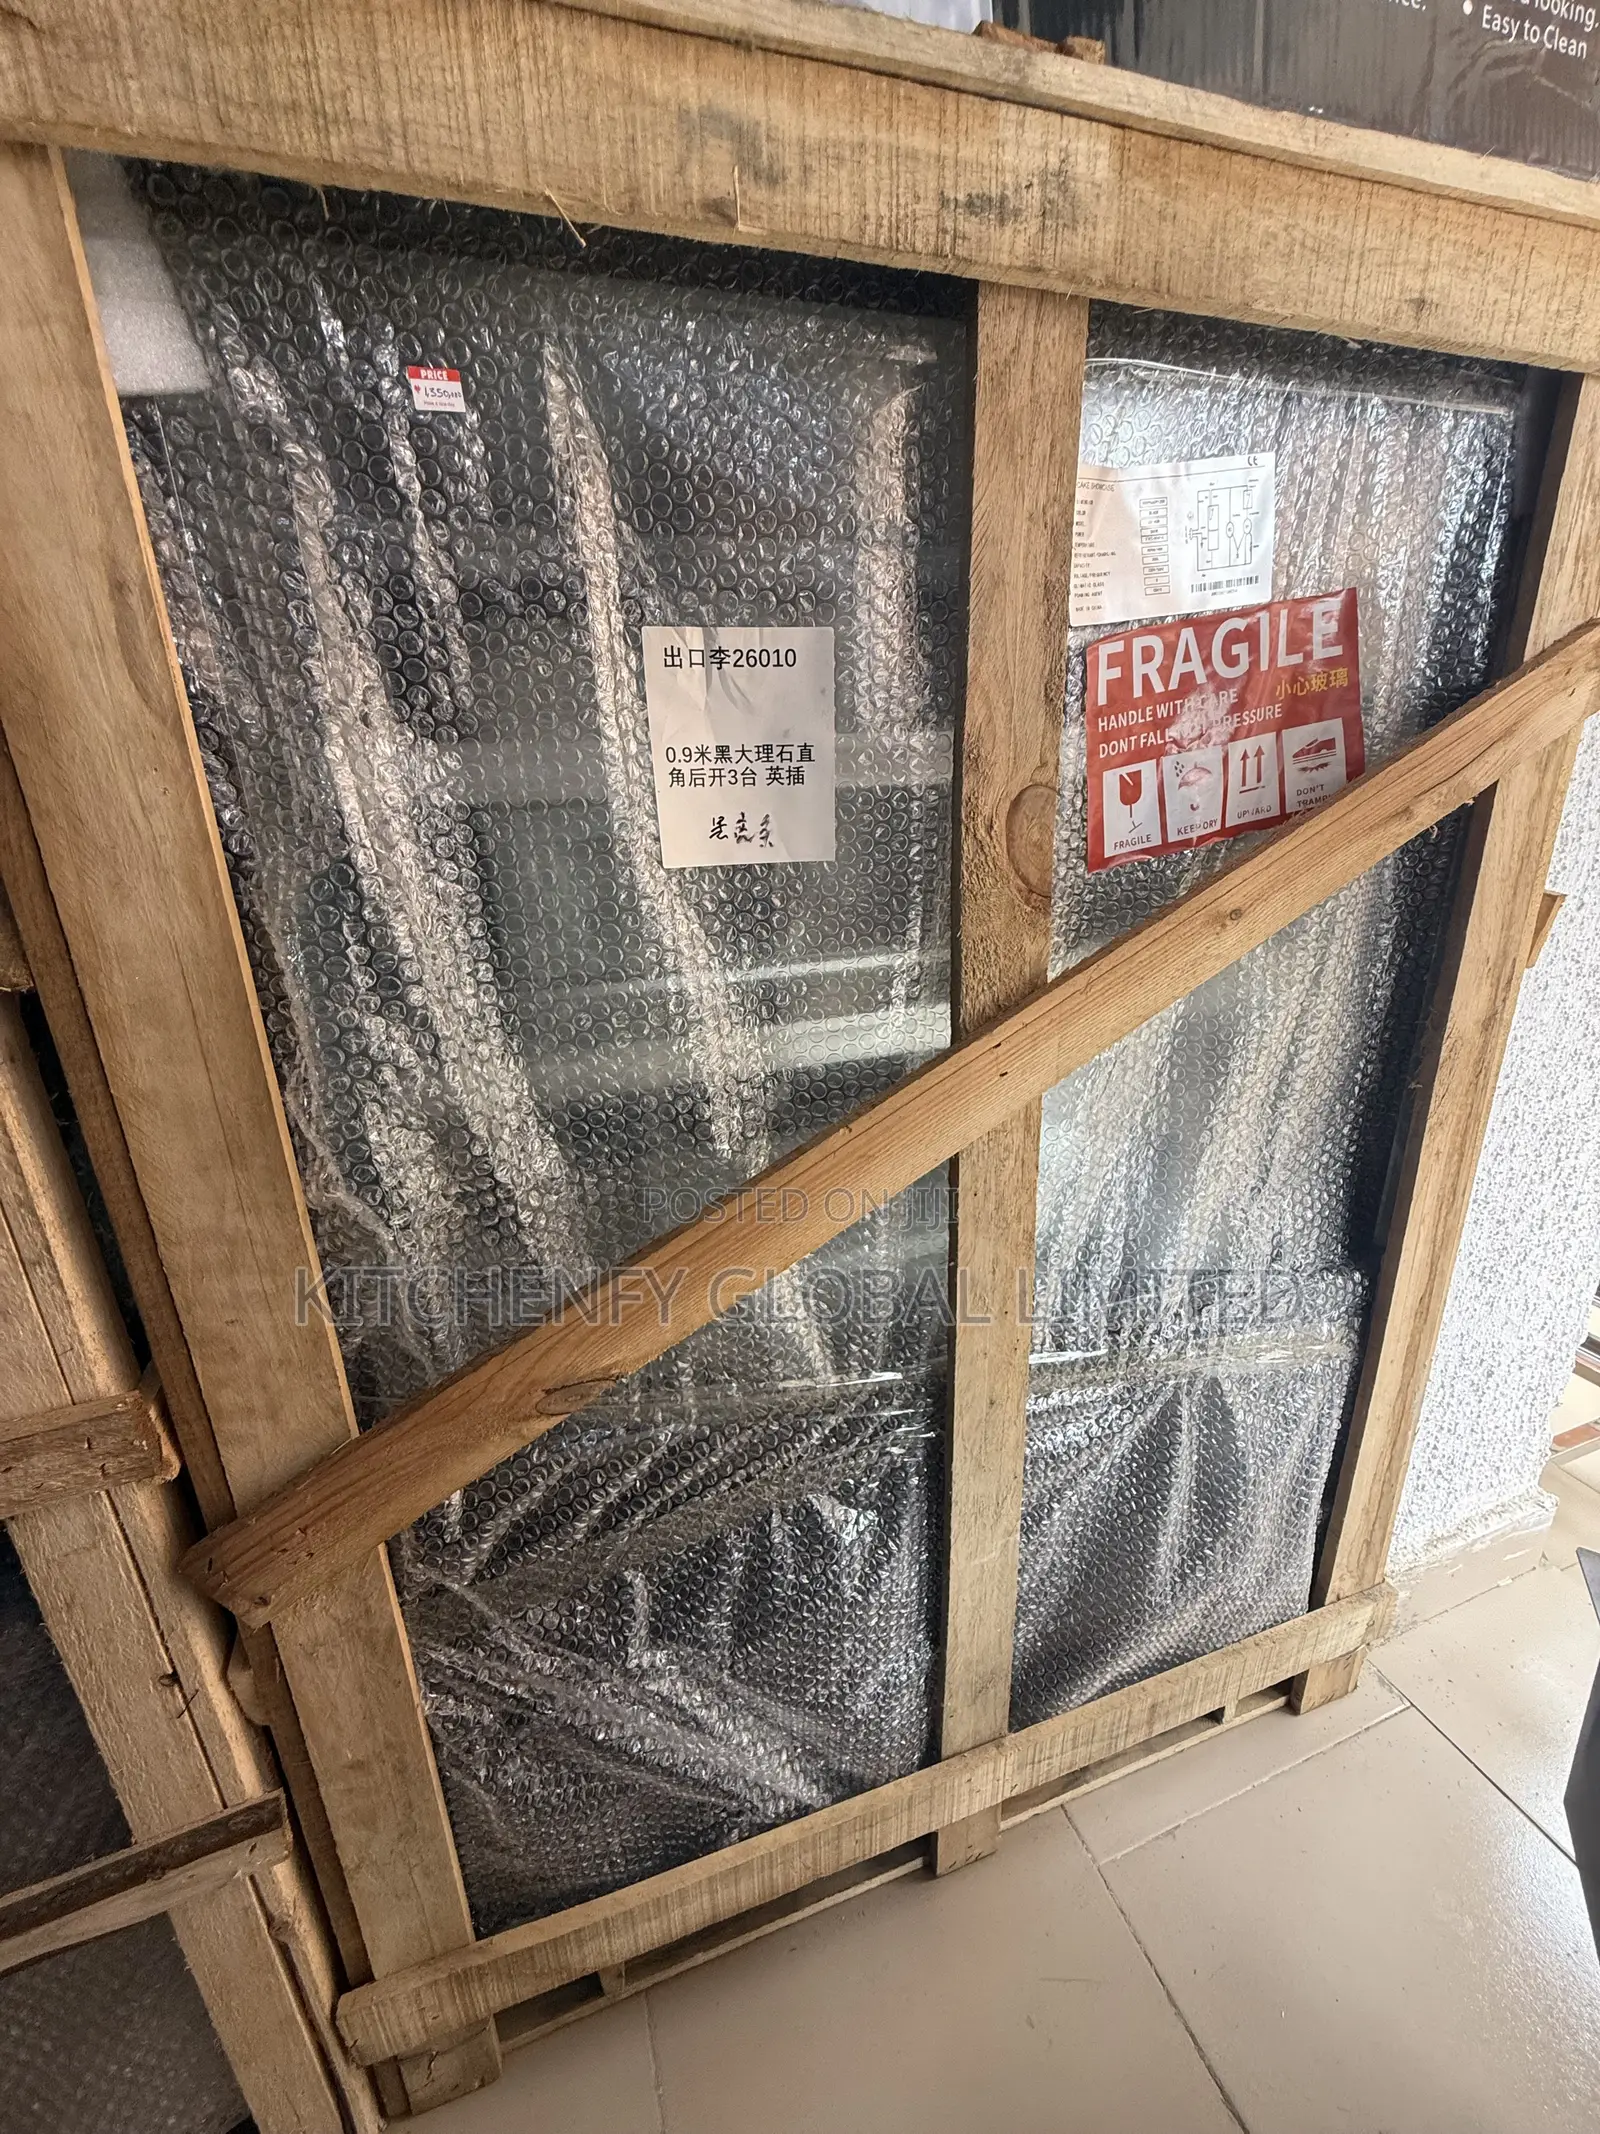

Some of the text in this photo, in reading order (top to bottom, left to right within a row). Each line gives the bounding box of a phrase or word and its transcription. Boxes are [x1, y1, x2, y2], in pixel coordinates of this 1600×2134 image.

[1482, 5, 1588, 59] Easy to Clean
[420, 369, 448, 380] PRICE
[663, 645, 797, 670] 出口李26010
[1097, 600, 1343, 706] FRAGILE
[1276, 668, 1349, 700] 小心玻璃
[1098, 706, 1153, 732] HANDLE
[1156, 697, 1193, 719] WITH
[1099, 735, 1137, 758] DONT
[1140, 728, 1174, 748] FALL
[1213, 703, 1282, 730] PRESSURE
[665, 743, 815, 765] 0.9米黑大理石直
[668, 765, 805, 788] 角后开3台 英插
[1296, 784, 1325, 796] DON'T
[1297, 794, 1332, 808] TRAMP
[1113, 834, 1152, 850] FRAGILE
